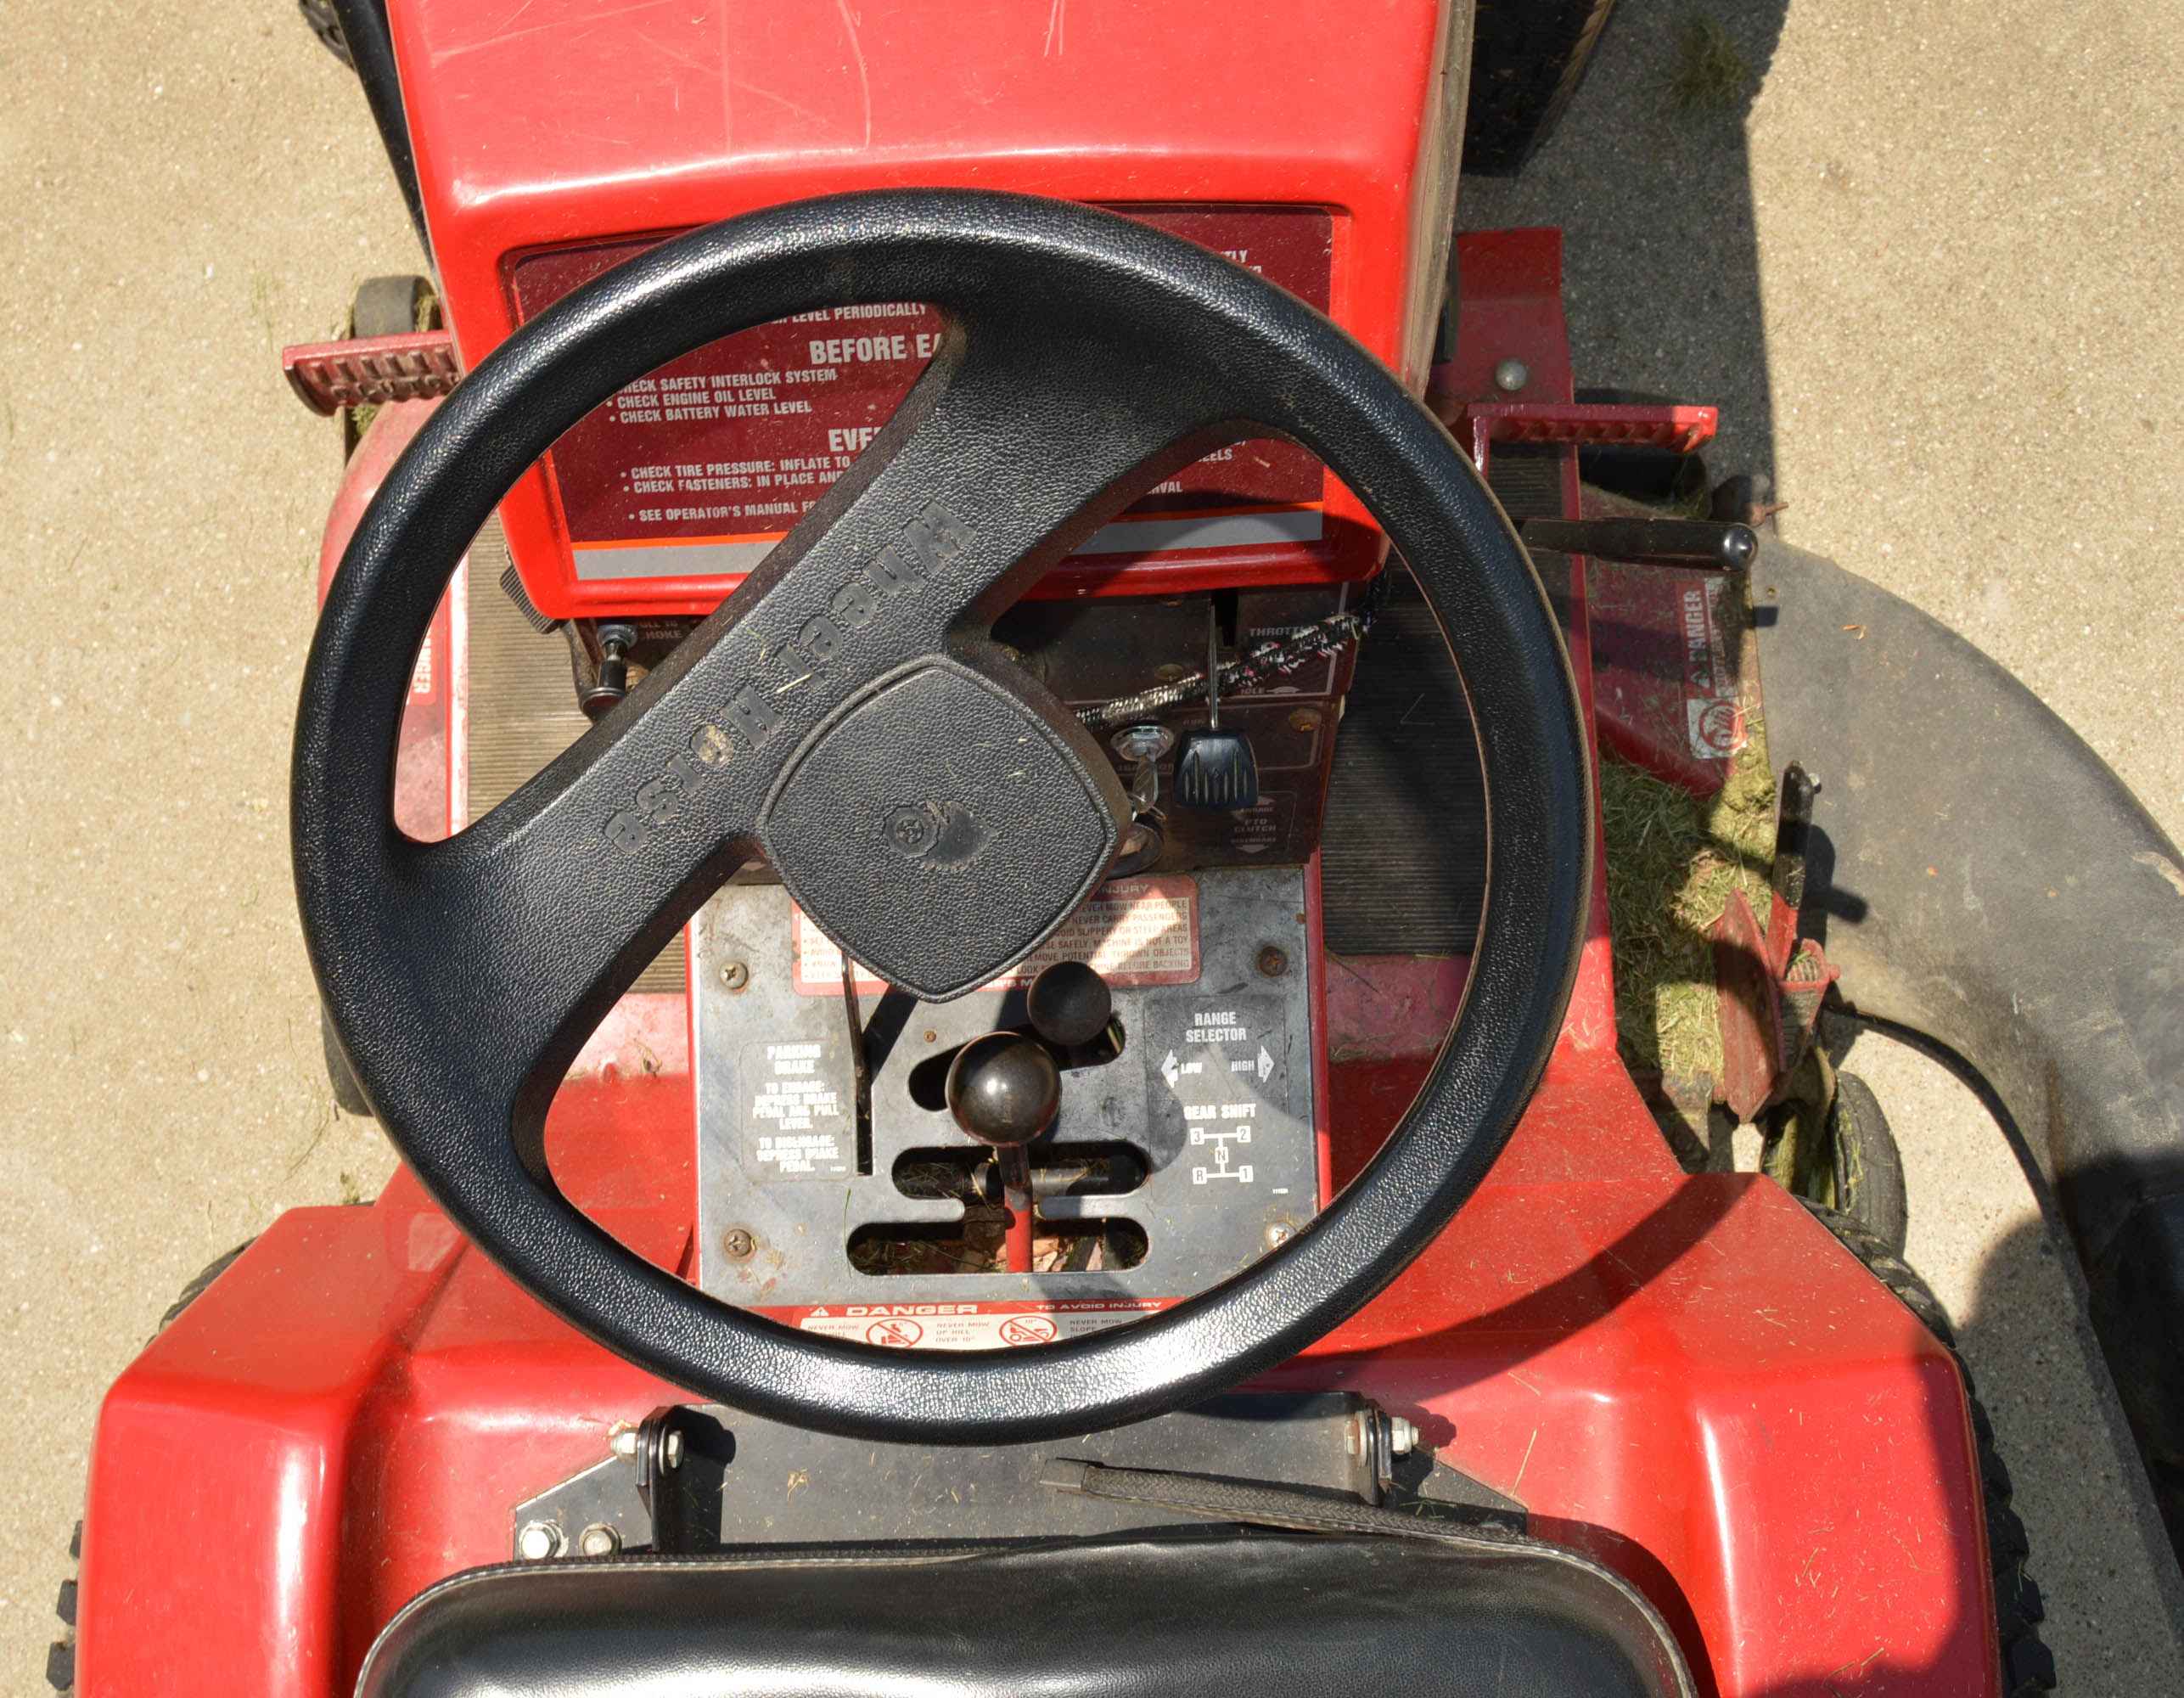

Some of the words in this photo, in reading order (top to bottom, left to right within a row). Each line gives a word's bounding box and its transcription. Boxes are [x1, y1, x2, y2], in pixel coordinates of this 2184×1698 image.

[834, 302, 926, 319] PERIODICALLY
[809, 335, 907, 365] BEFORE
[660, 376, 707, 392] SAFETY
[710, 371, 782, 388] INTERLOCK
[785, 368, 838, 384] SYSTEM
[617, 394, 660, 408] CHECK
[662, 391, 711, 406] ENGINE
[714, 390, 735, 403] OIL
[738, 387, 777, 402] LEVEL
[620, 409, 661, 424] CHECK
[665, 405, 721, 421] BATTERY
[725, 402, 770, 417] WATER
[774, 400, 812, 414] LEVEL
[631, 465, 672, 480] CHECK
[676, 464, 704, 477] TIRE
[707, 460, 776, 475] PRESSURE:
[779, 458, 831, 471] INFLATE
[836, 455, 851, 468] TO
[633, 480, 675, 493] CHECK
[678, 475, 753, 491] FASTENERS:
[756, 474, 771, 487] IN
[774, 471, 814, 486] PLACE
[638, 509, 663, 521] SEE
[665, 504, 742, 520] OPERATOR'S
[744, 502, 798, 516] MANUAL
[1102, 884, 1148, 894] NJURY
[1081, 901, 1104, 913] EVER
[1106, 901, 1127, 911] MOW
[1073, 915, 1101, 925] NEVER
[1045, 941, 1054, 950] SE
[1174, 936, 1187, 944] TOY
[1194, 1011, 1237, 1026] RANGE
[1185, 1027, 1247, 1043] SELECTOR
[1181, 1062, 1203, 1074] LOW
[1231, 1060, 1255, 1072] HIGH
[765, 1082, 779, 1094] TO
[1183, 1105, 1216, 1120] GEAR
[1221, 1103, 1257, 1119] SHIFT
[1193, 1131, 1201, 1143] 3
[1239, 1128, 1248, 1141] 2
[1217, 1150, 1226, 1161] N
[1196, 1170, 1204, 1181] R
[1243, 1168, 1248, 1179] 1
[845, 1303, 979, 1317] DANGER
